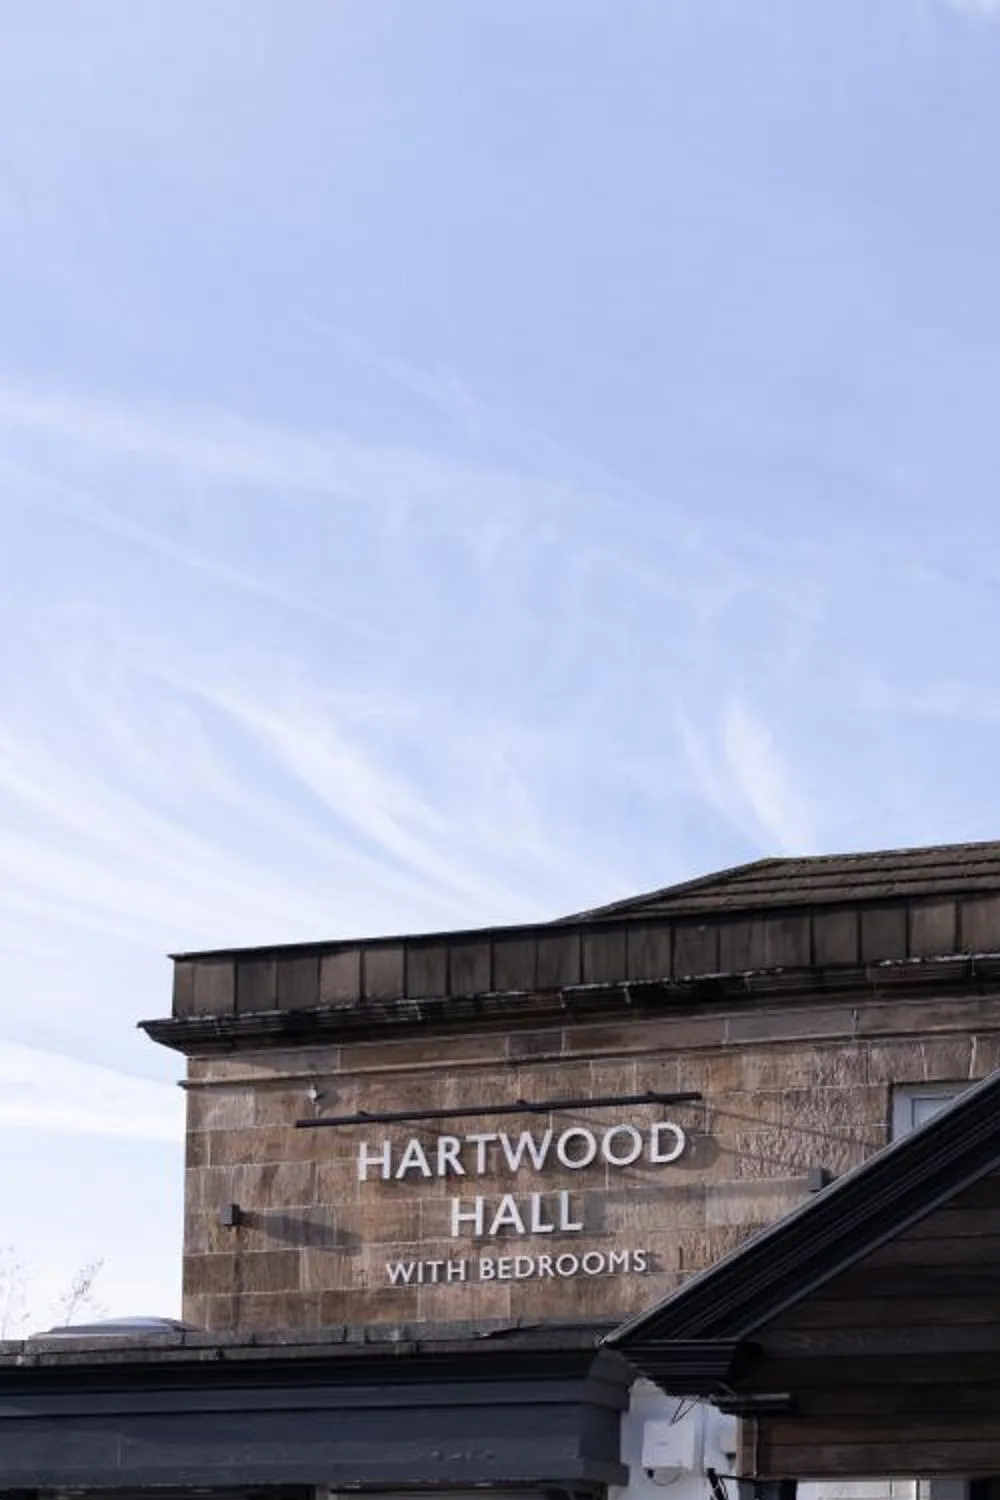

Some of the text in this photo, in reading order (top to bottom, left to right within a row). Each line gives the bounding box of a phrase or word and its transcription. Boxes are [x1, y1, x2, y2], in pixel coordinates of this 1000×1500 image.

[357, 1122, 686, 1181] HARTWOOD
[451, 1190, 583, 1237] HALL
[385, 1249, 647, 1285] WITH BEDROOMS
